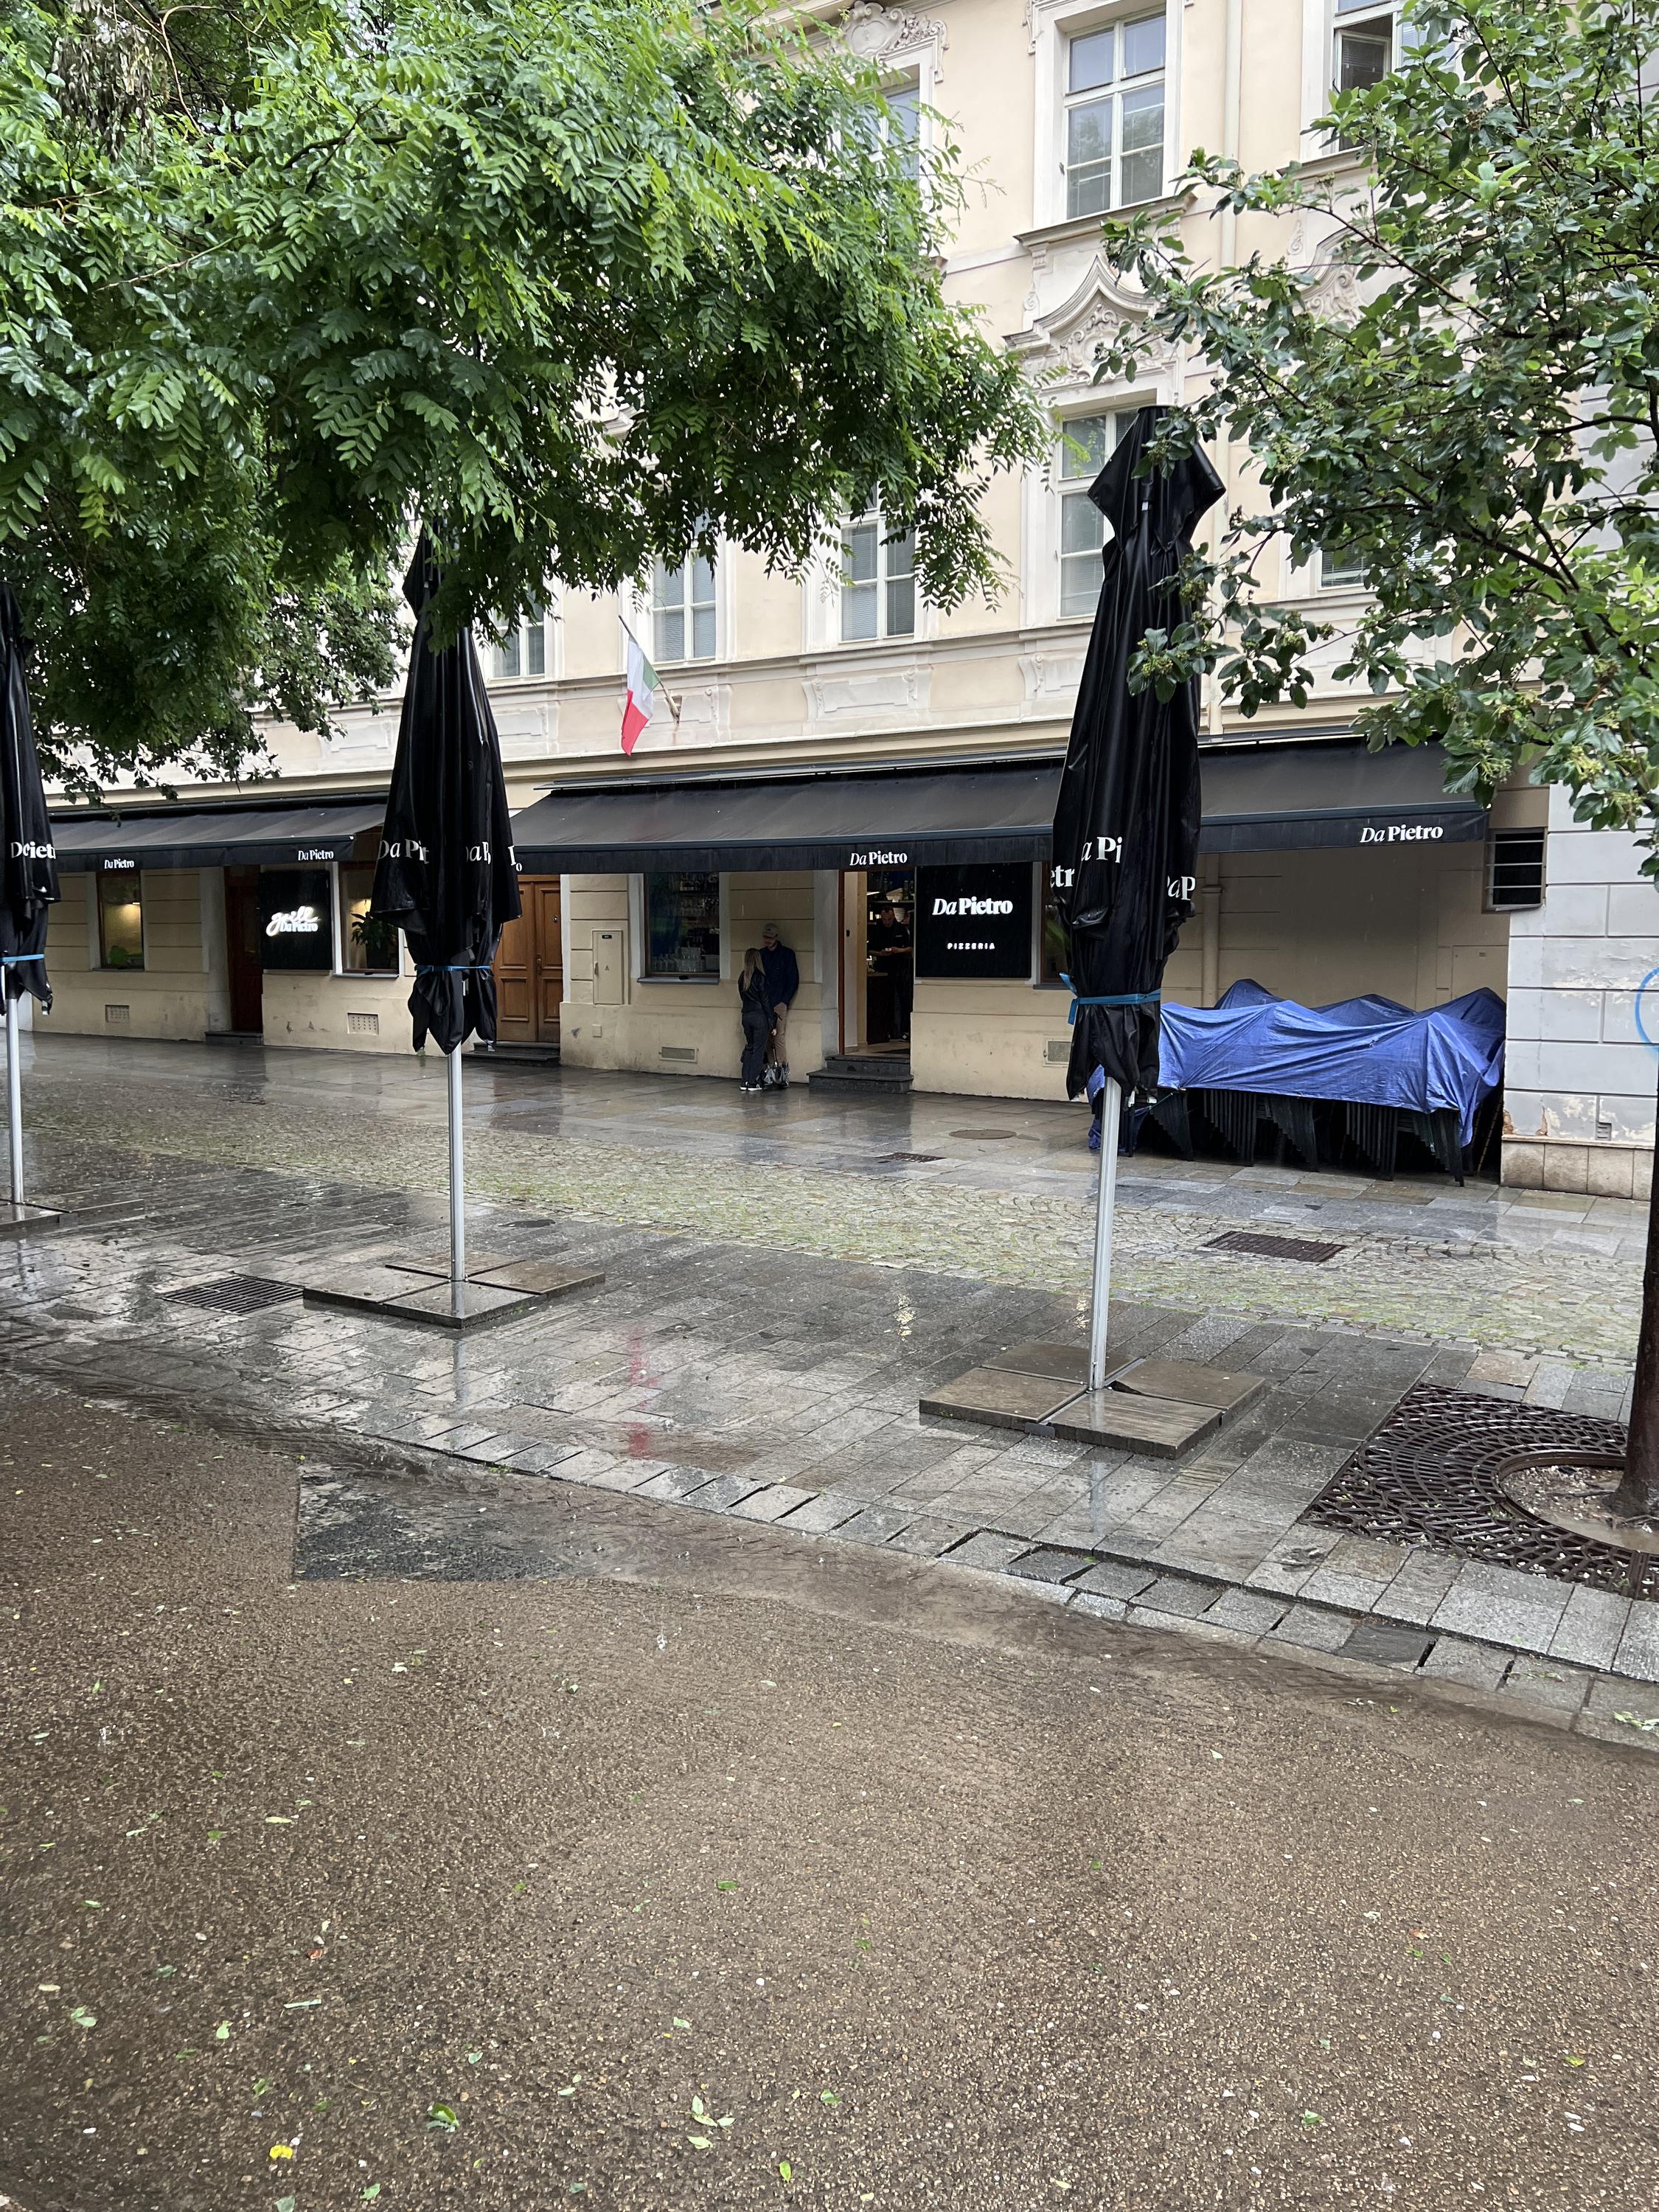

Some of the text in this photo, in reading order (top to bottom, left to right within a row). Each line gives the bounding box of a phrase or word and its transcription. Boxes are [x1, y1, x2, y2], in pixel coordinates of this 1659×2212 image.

[1360, 824, 1443, 843] Da Pietro
[298, 849, 334, 860] Da Pietro
[849, 850, 908, 866] Da Pietro
[104, 858, 134, 869] Da Pietro
[932, 896, 1013, 915] Da Pietro
[265, 905, 319, 936] grill
